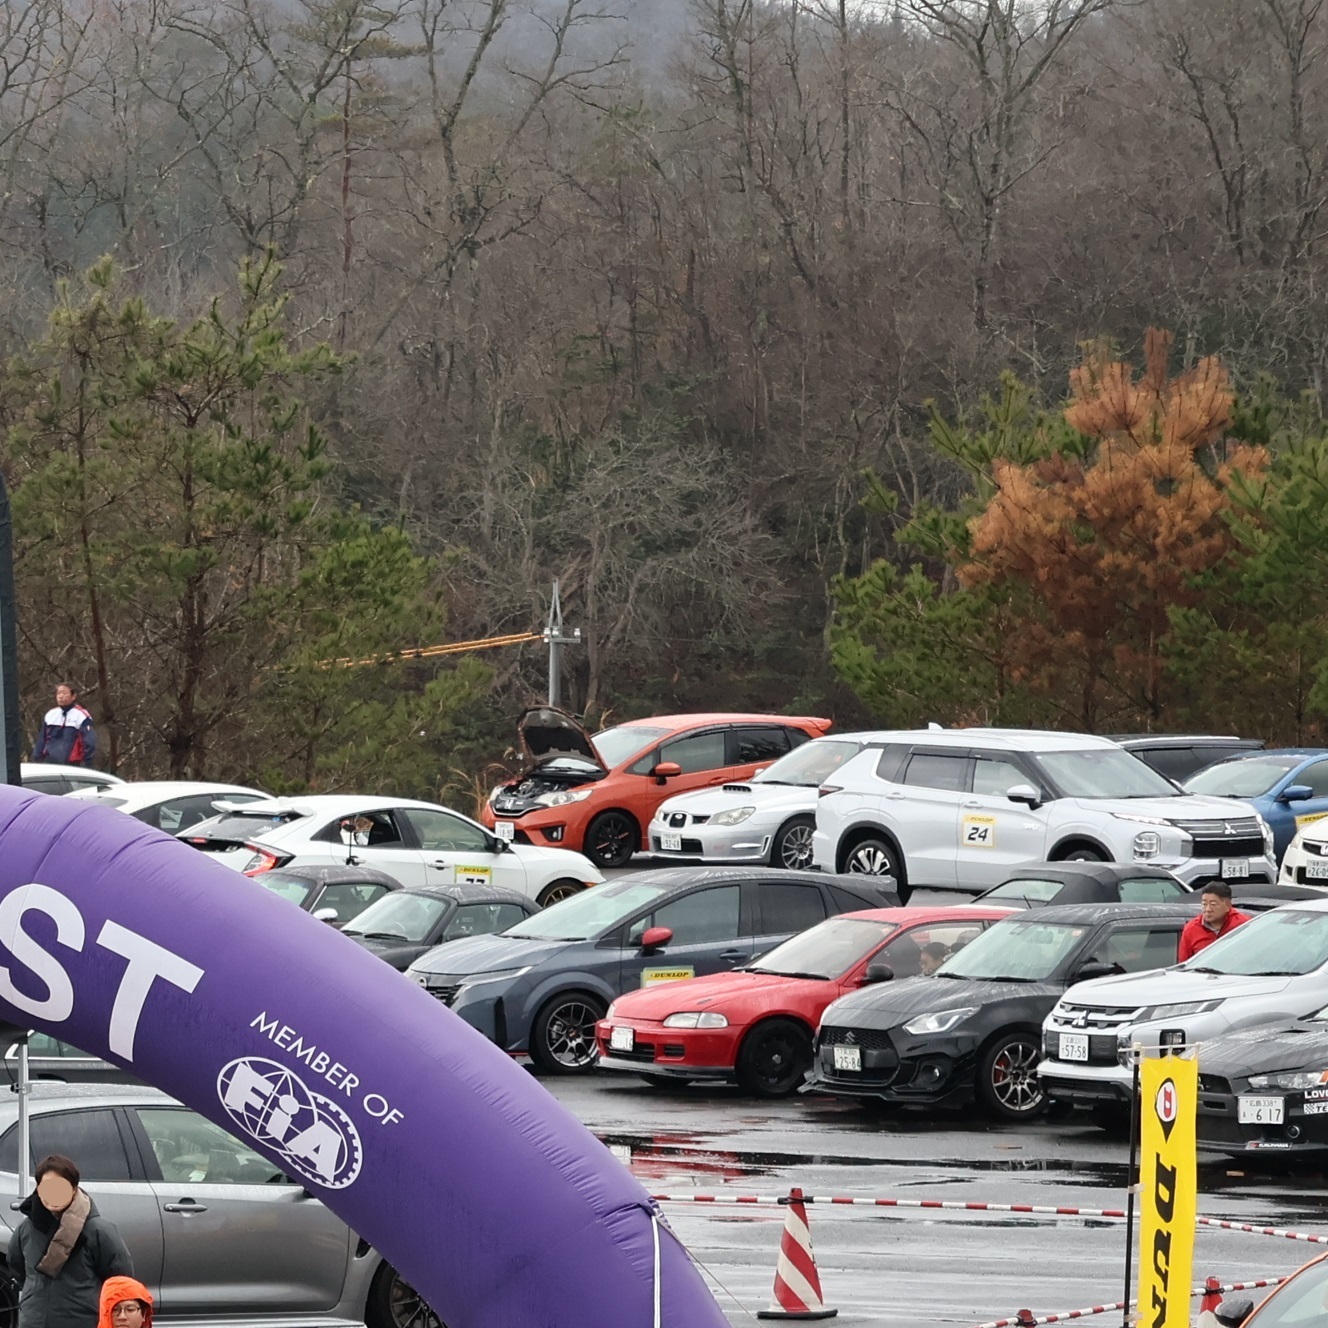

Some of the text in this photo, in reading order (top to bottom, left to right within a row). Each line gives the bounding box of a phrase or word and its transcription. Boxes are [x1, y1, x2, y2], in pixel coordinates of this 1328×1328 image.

[967, 827, 989, 842] 24
[249, 1011, 405, 1126] MEMBER OF
